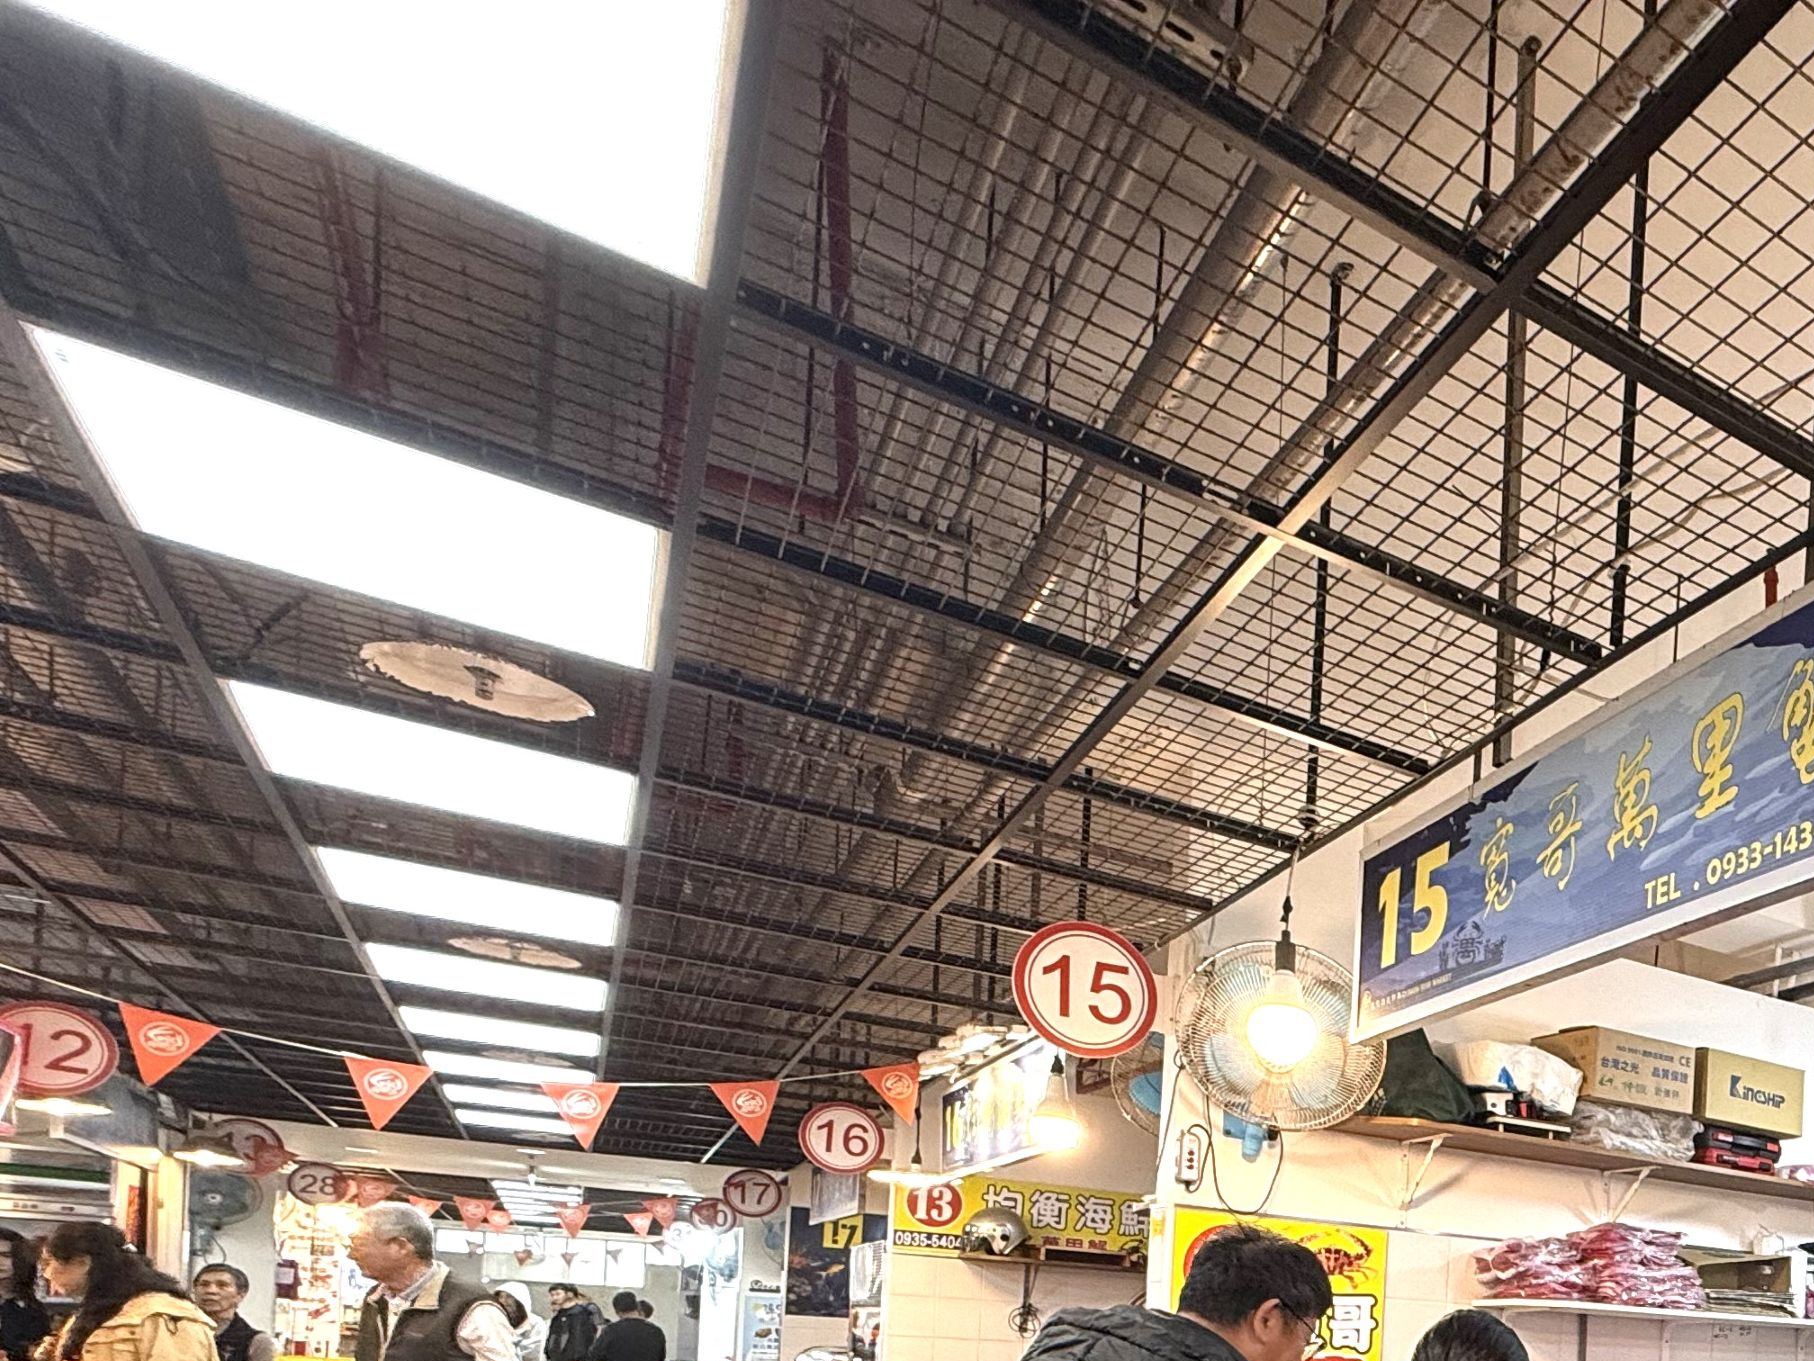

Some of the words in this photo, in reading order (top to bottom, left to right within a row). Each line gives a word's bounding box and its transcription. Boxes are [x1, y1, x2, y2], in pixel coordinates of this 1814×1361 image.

[1379, 840, 1450, 969] 15
[1644, 872, 1681, 909] TEL
[1043, 955, 1132, 1025] 15
[816, 1119, 870, 1157] 16
[300, 1173, 336, 1196] 28
[729, 1181, 770, 1206] 17
[913, 1186, 954, 1222] 13
